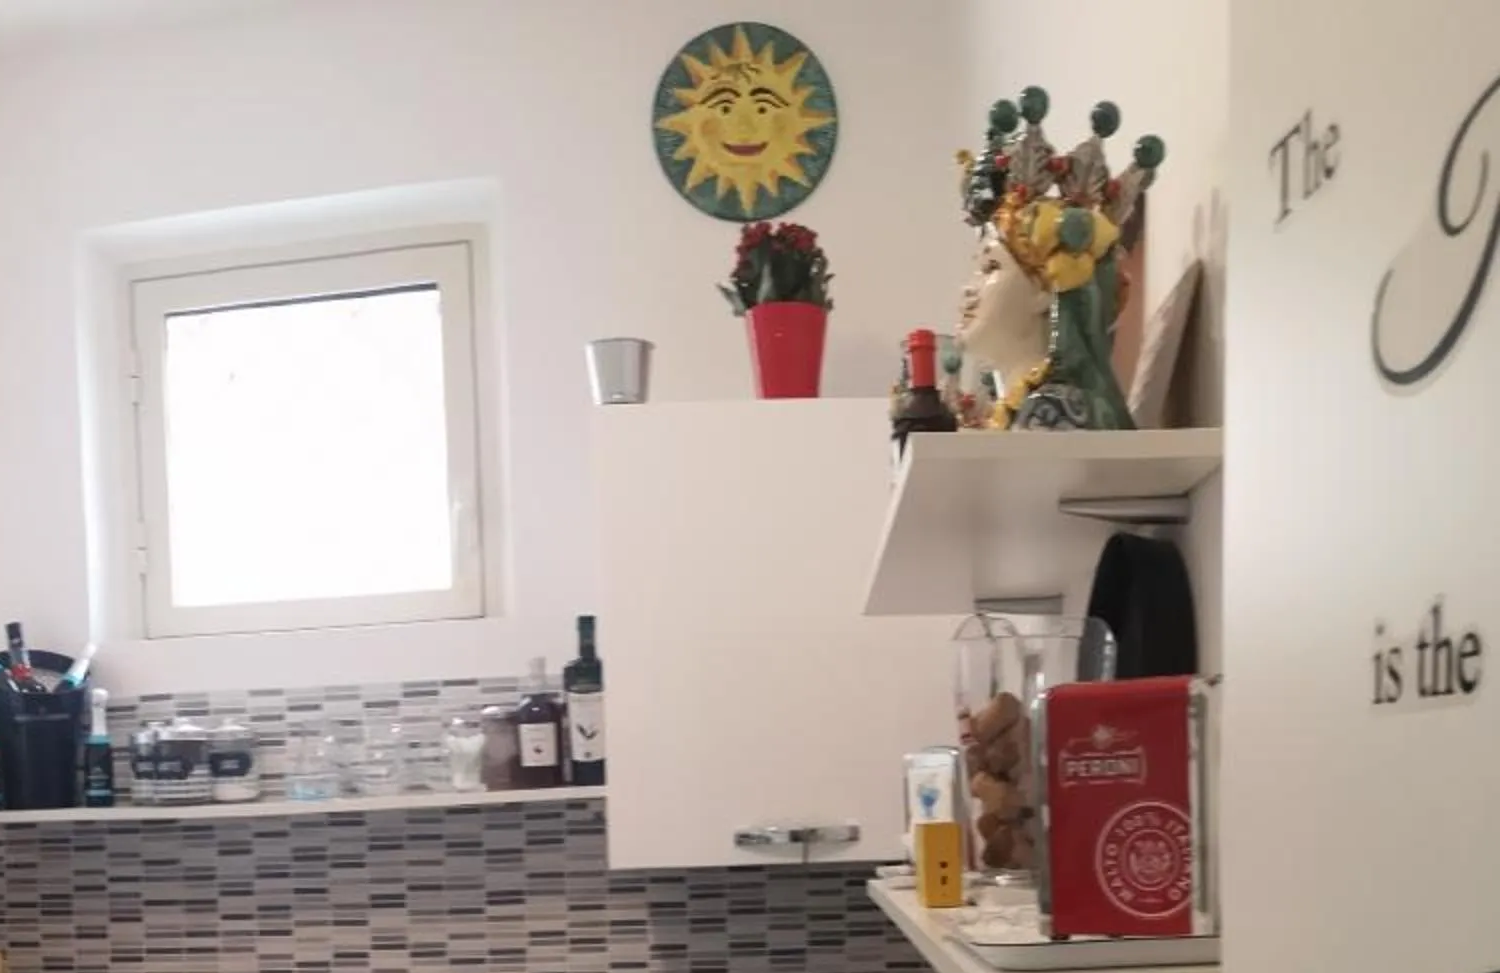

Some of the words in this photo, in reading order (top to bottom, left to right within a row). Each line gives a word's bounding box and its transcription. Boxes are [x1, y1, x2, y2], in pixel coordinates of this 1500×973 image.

[1268, 106, 1342, 228] The
[1372, 622, 1402, 705] is
[1415, 602, 1483, 698] the
